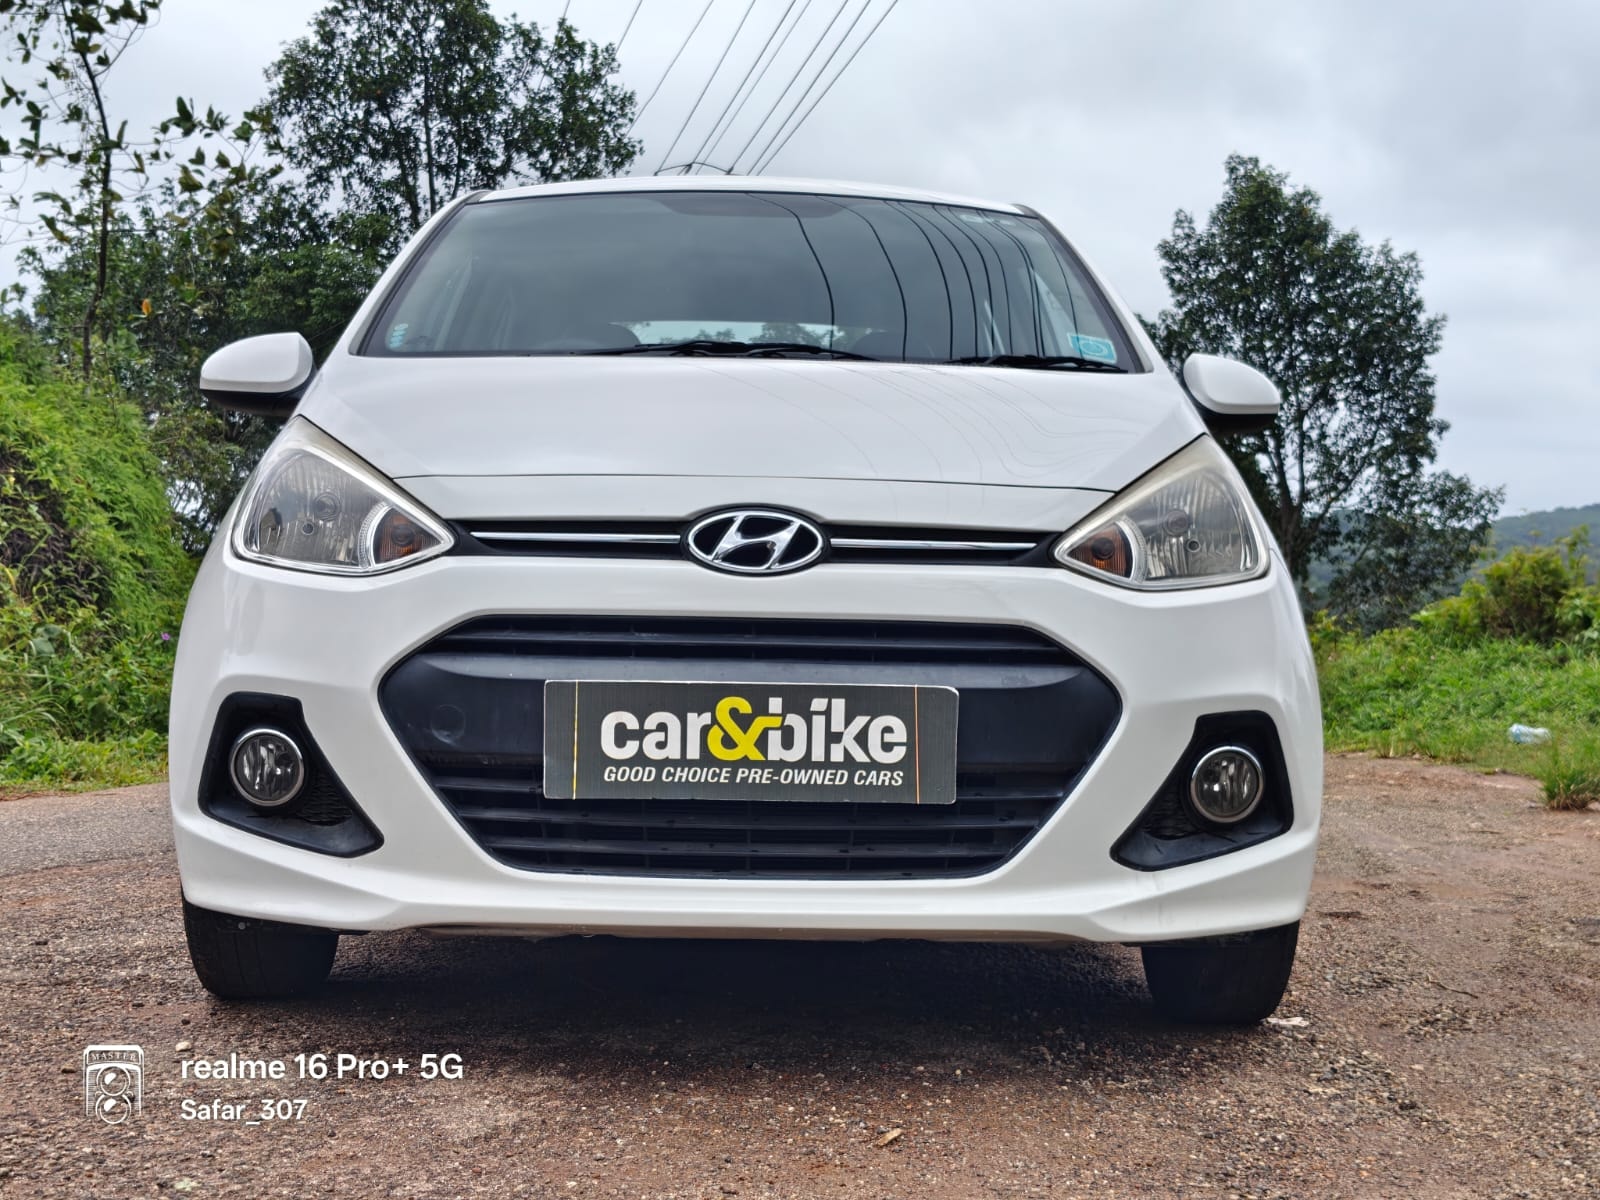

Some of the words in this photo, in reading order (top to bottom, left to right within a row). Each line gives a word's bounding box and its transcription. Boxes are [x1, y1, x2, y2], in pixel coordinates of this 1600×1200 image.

[600, 696, 908, 764] car&bike
[603, 766, 656, 783] GOOD
[661, 767, 732, 784] CHOICE
[736, 768, 849, 786] PRE-OWNED
[853, 769, 904, 787] CARS
